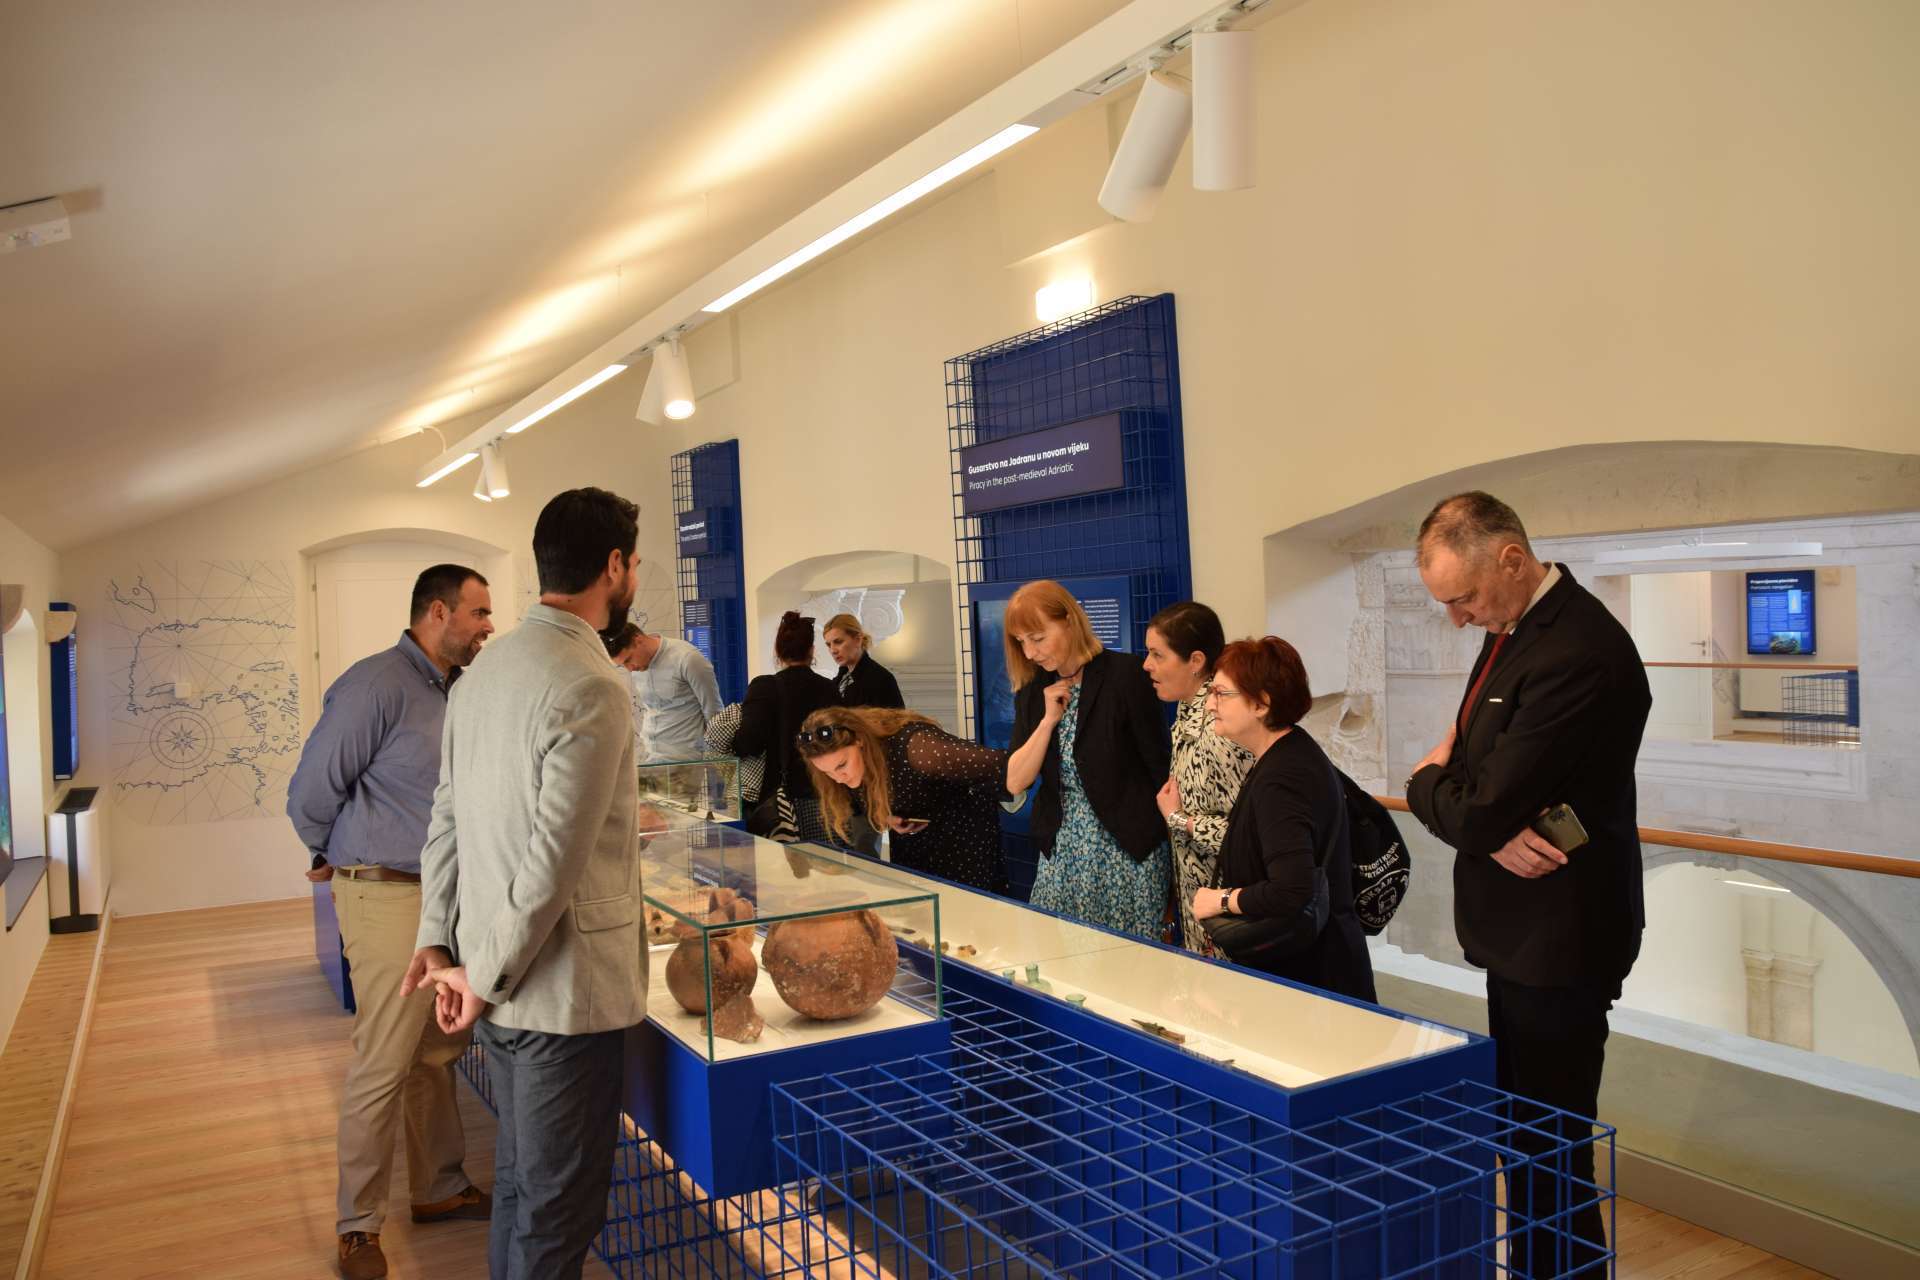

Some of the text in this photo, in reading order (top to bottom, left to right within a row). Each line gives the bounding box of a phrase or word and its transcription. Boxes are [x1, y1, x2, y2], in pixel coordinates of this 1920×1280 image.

[968, 462, 999, 474] Gusarstvo
[1000, 460, 1009, 468] na
[1009, 453, 1036, 466] Jadranu
[1042, 447, 1067, 458] novom
[1067, 442, 1090, 456] vijeku
[969, 462, 1074, 490] Piracy in the post-medieval Adriatic
